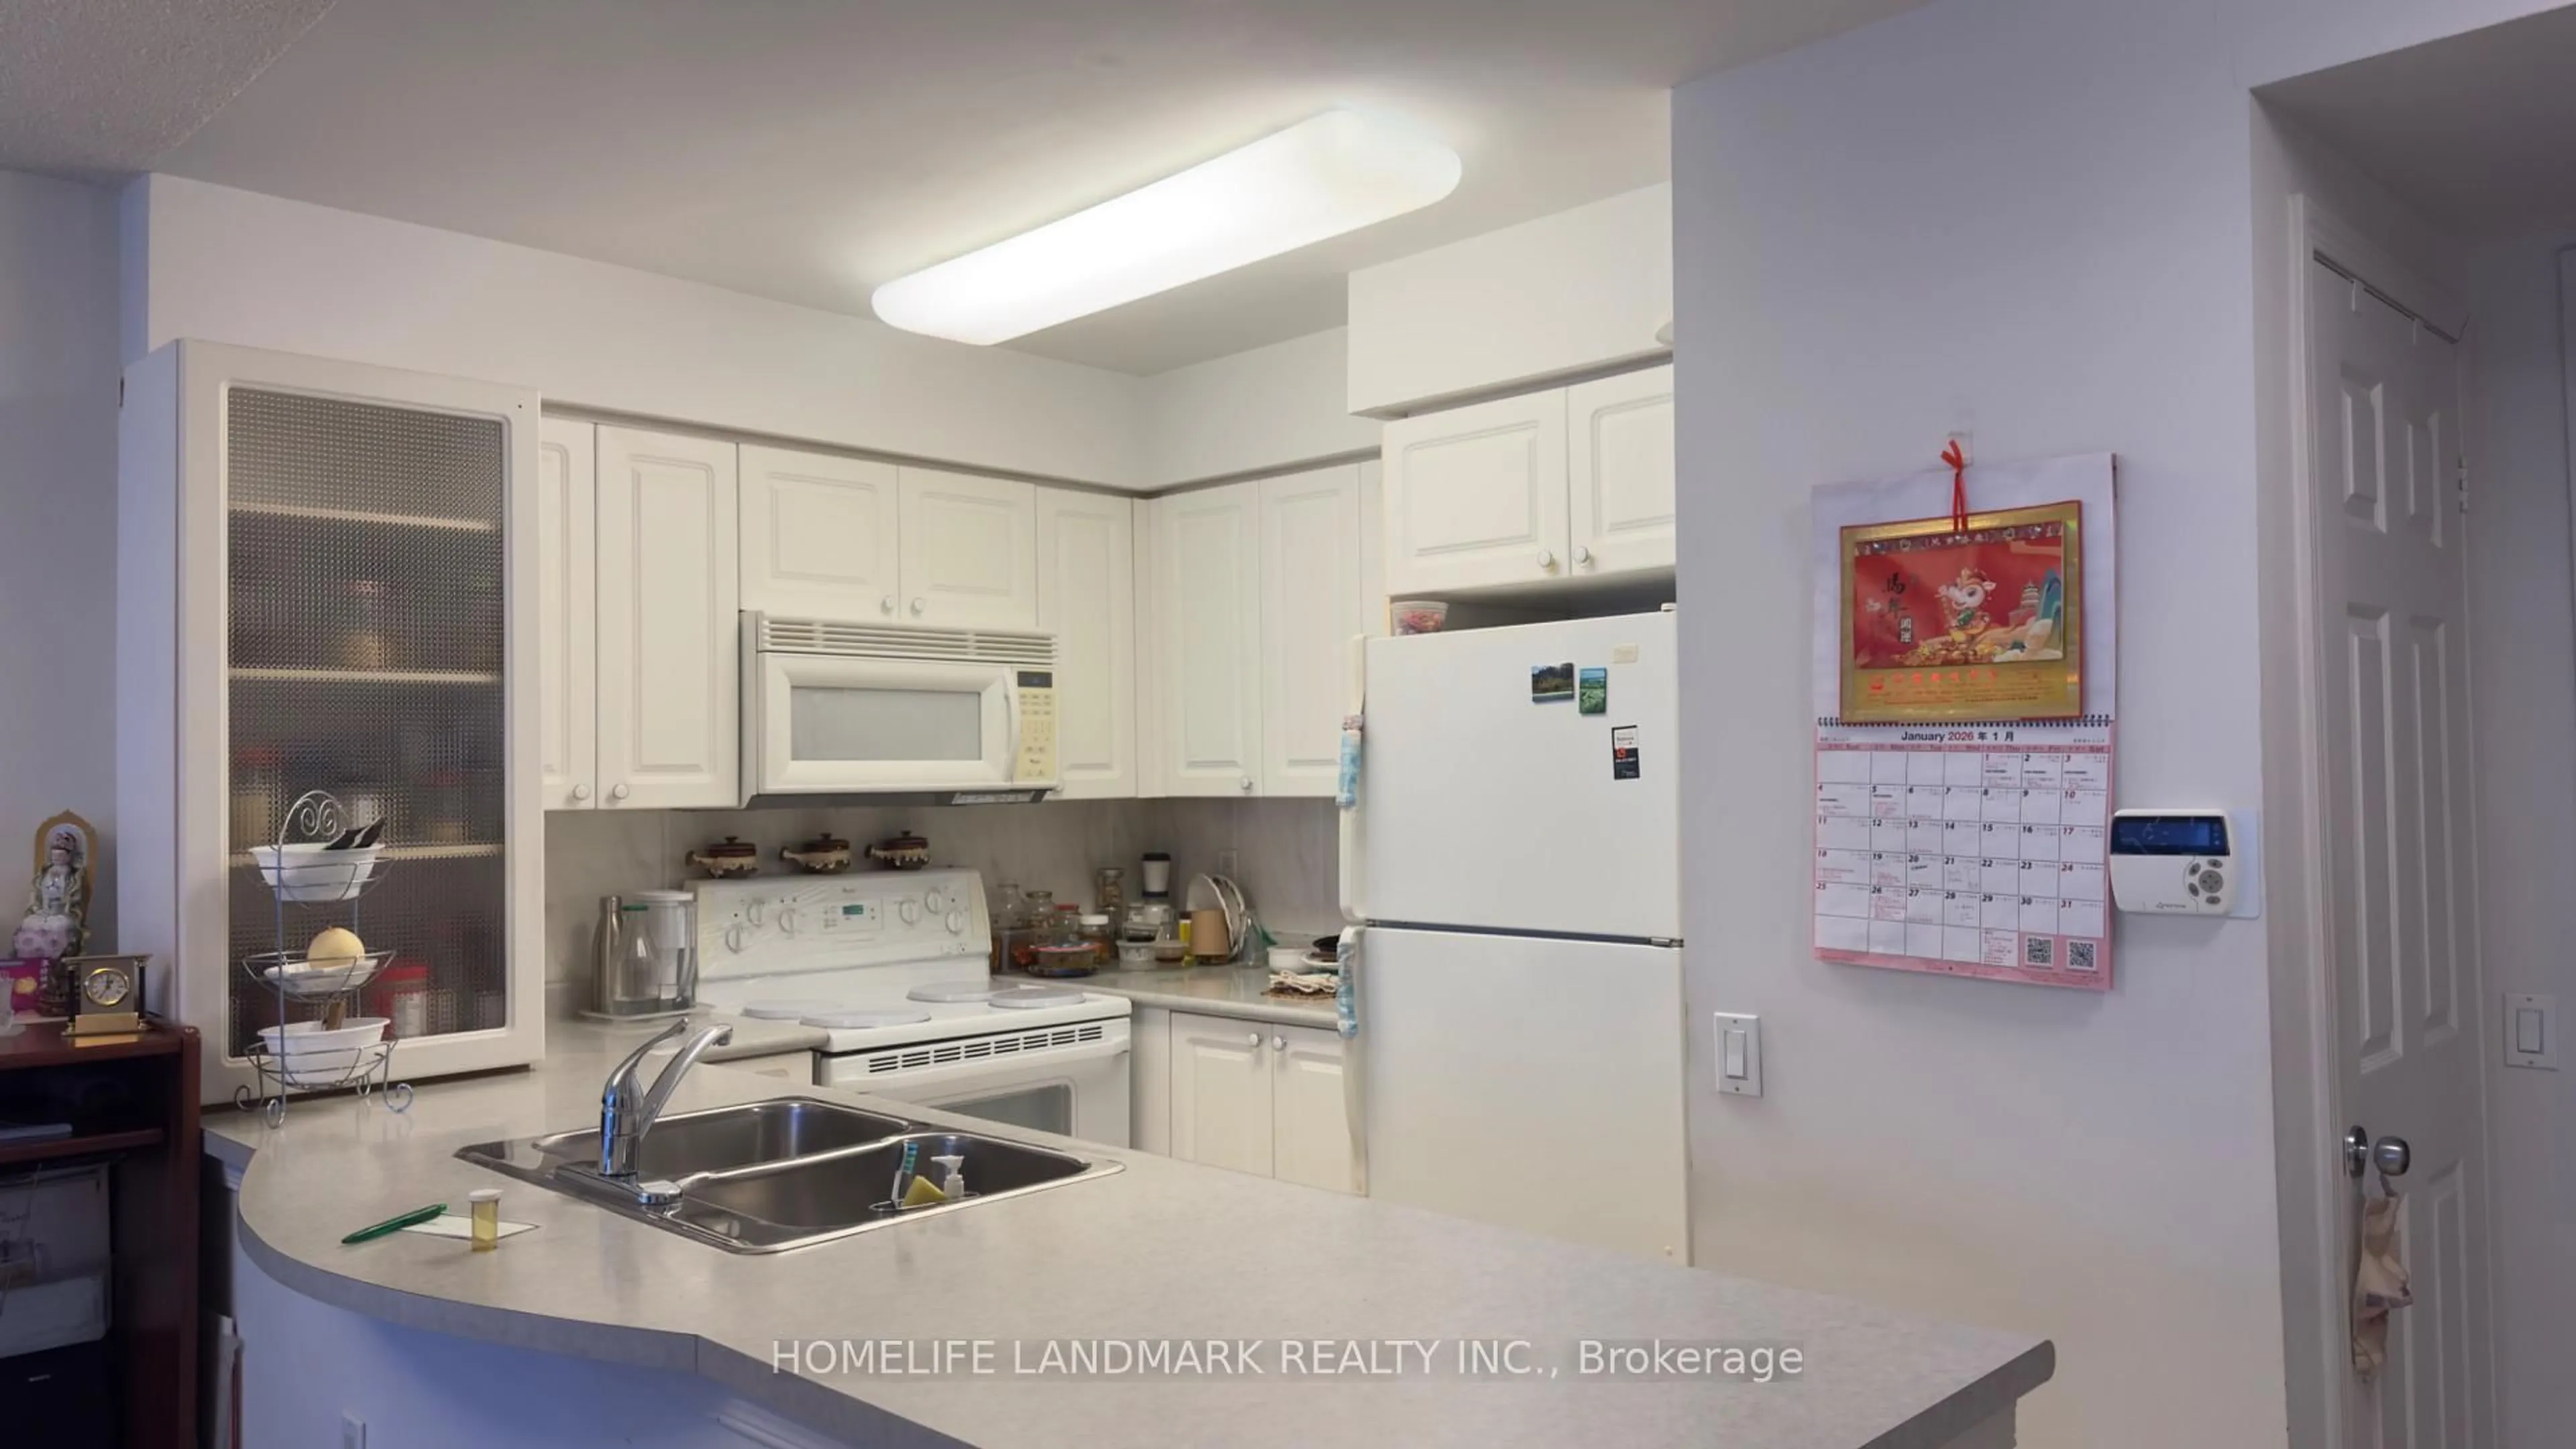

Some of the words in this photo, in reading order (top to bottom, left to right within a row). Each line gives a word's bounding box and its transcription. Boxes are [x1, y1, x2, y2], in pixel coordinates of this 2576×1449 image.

[1901, 731, 1945, 743] January
[1948, 731, 1974, 741] 2026
[1978, 731, 1988, 741] 年
[1992, 732, 1998, 741] 1
[2004, 731, 2014, 742] 月
[2064, 791, 2076, 799] 10
[1909, 855, 1919, 863] 20
[2021, 861, 2033, 869] 23
[1945, 892, 1956, 900] 28
[2021, 896, 2033, 905] 30
